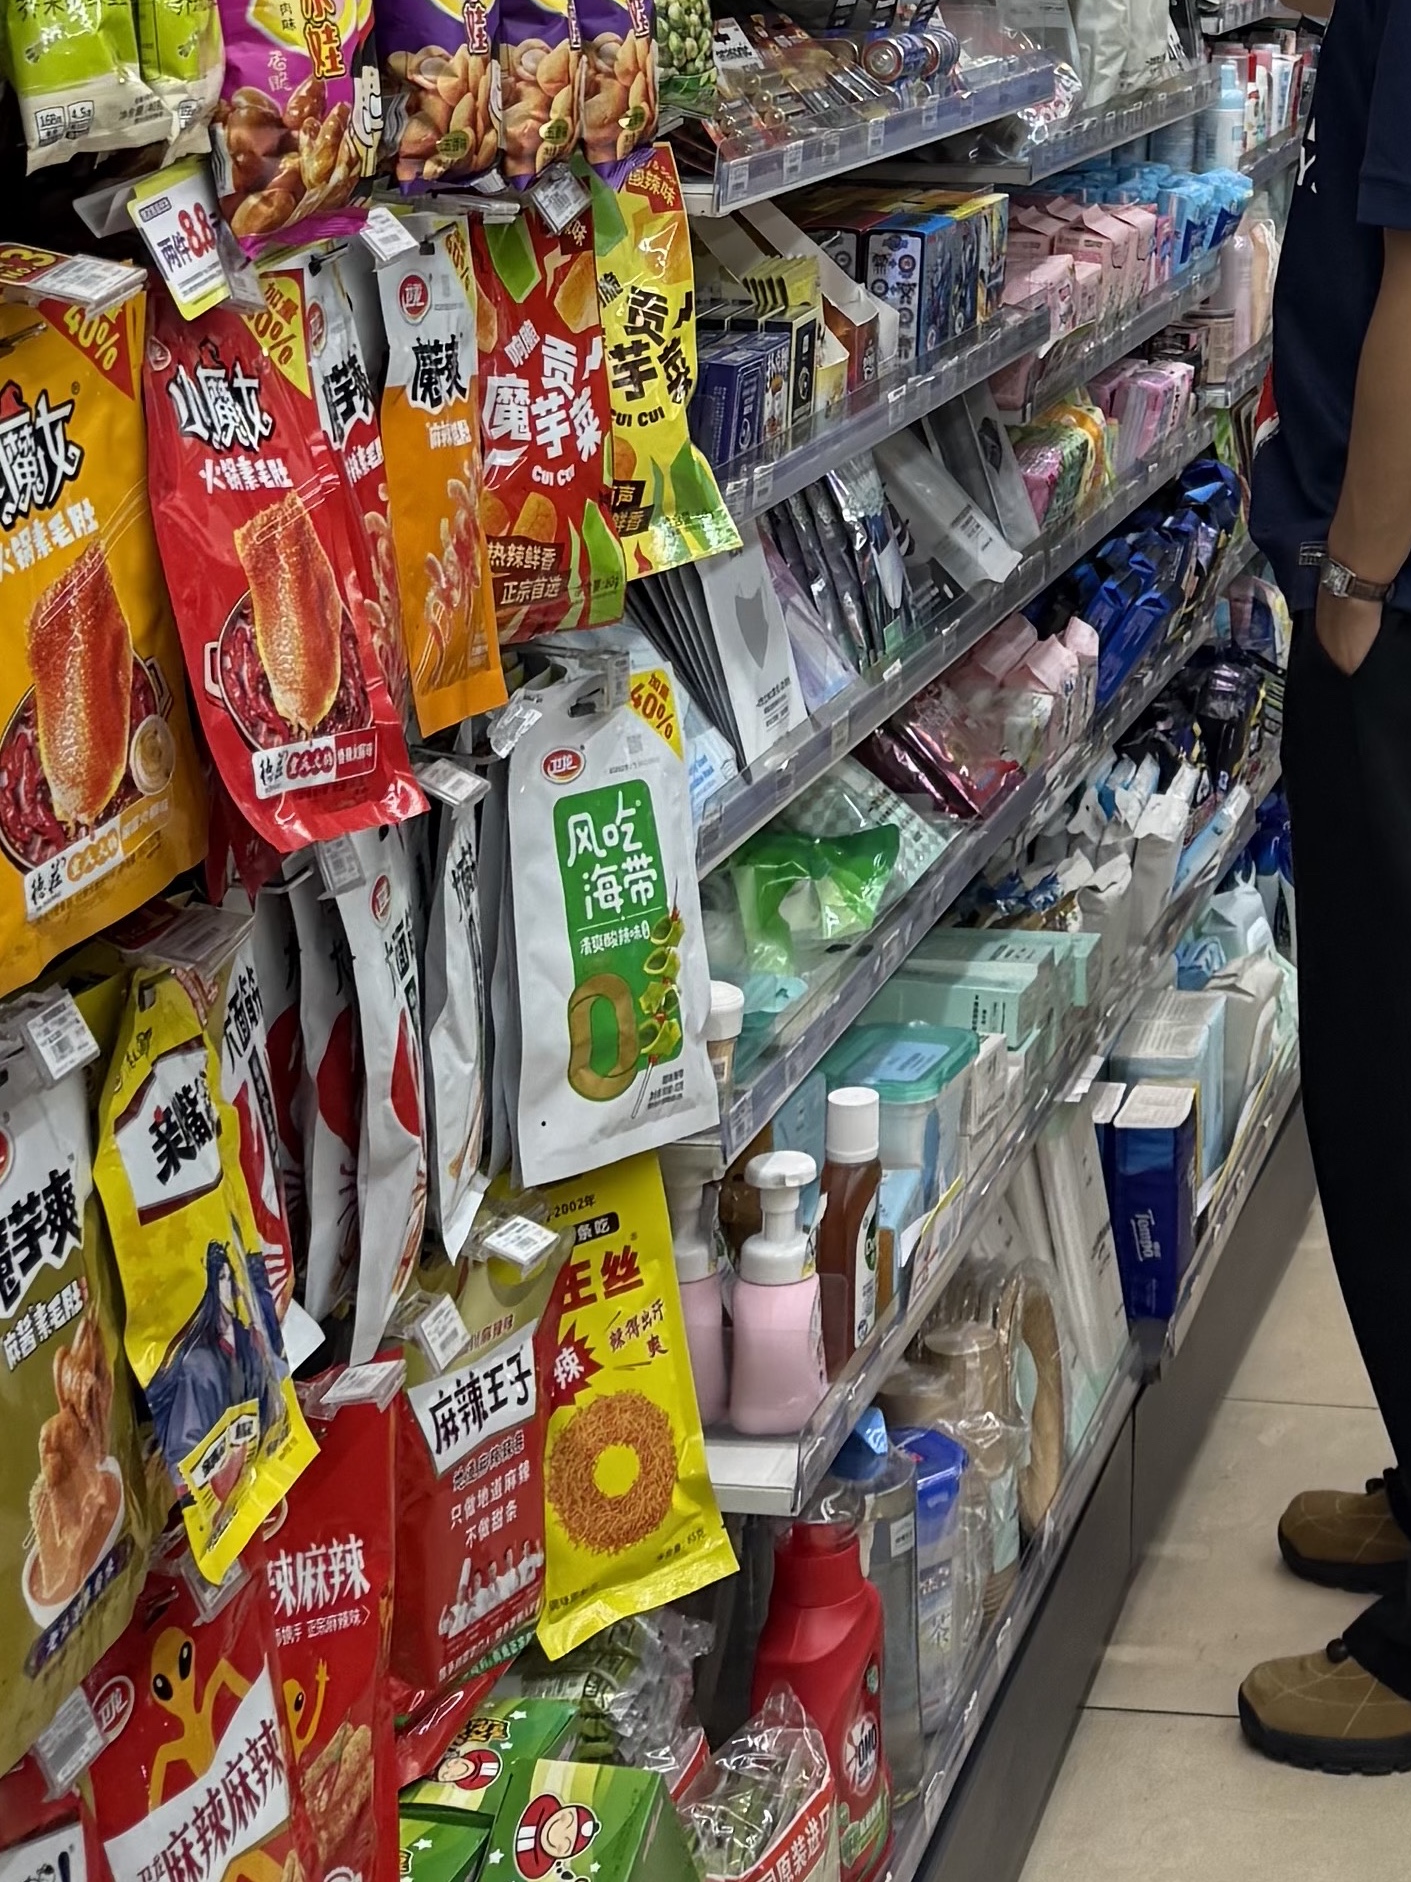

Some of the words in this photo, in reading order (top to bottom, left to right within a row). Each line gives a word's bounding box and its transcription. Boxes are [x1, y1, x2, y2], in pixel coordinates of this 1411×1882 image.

[199, 455, 295, 496] 火锅素毛肚
[488, 542, 557, 571] 热辣鲜香
[501, 578, 563, 605] 正宗首选
[630, 683, 670, 740] 40%
[567, 790, 645, 868] 风吃
[583, 852, 659, 921] 海带
[579, 919, 651, 956] 清爽酸辣味
[1132, 1208, 1162, 1264] Tempo
[428, 1354, 534, 1455] 麻辣王子
